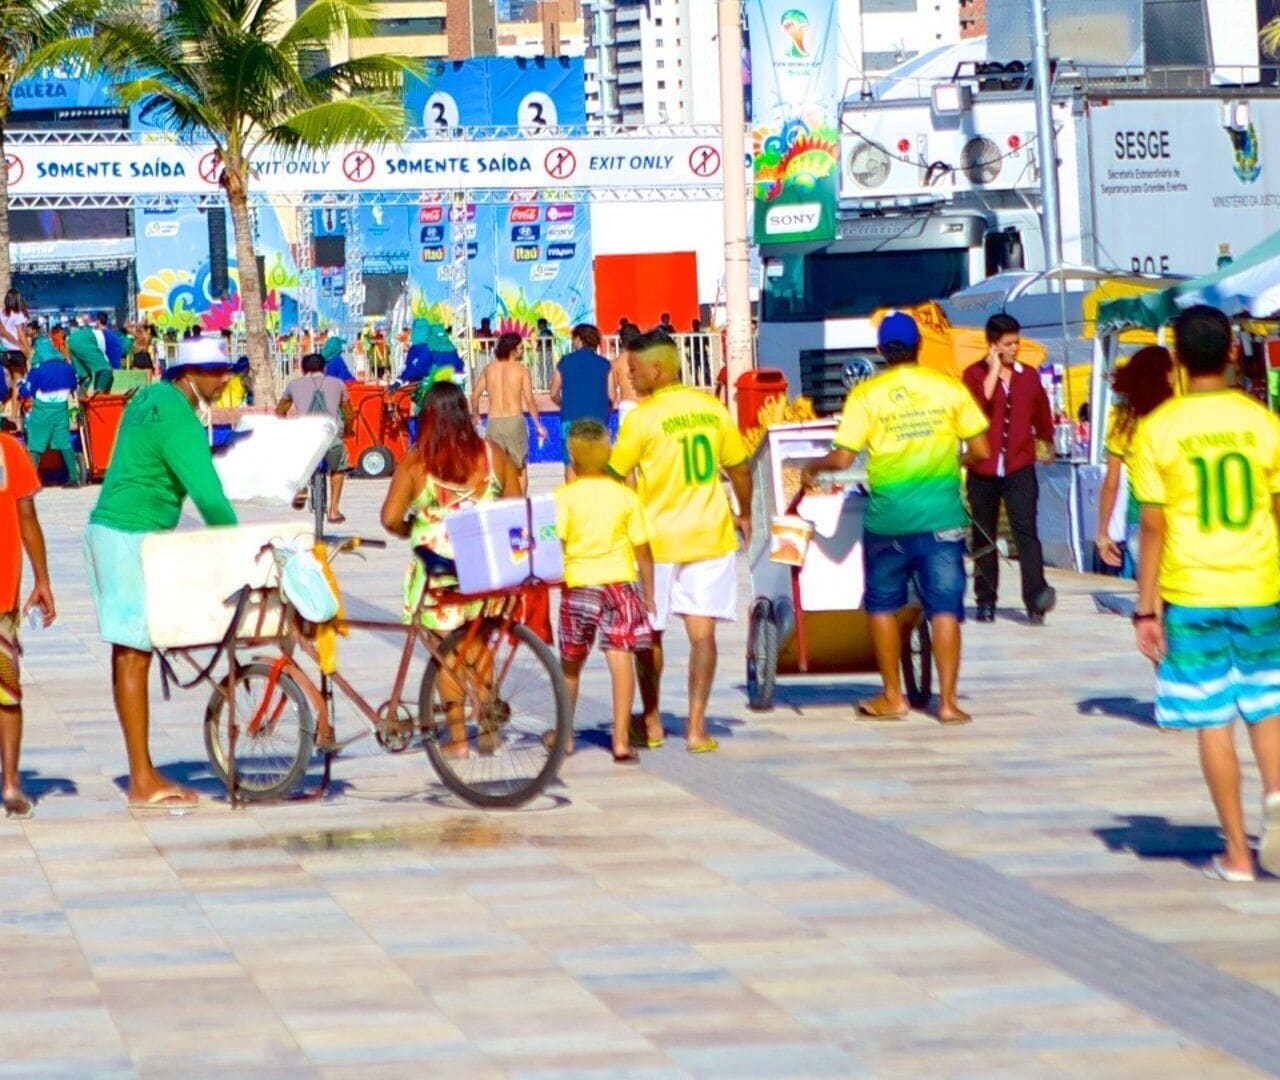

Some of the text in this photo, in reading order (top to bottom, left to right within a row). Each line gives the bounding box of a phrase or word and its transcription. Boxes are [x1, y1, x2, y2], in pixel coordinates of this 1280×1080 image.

[1114, 131, 1171, 159] SESGE
[36, 158, 185, 178] SOMENTE SAÍDA
[286, 160, 331, 174] ONLY
[385, 153, 532, 175] SOMENTE SAÍDA
[589, 154, 674, 170] EXIT ONLY
[769, 212, 817, 227] SONY
[676, 433, 714, 486] 10
[1191, 452, 1255, 533] 10
